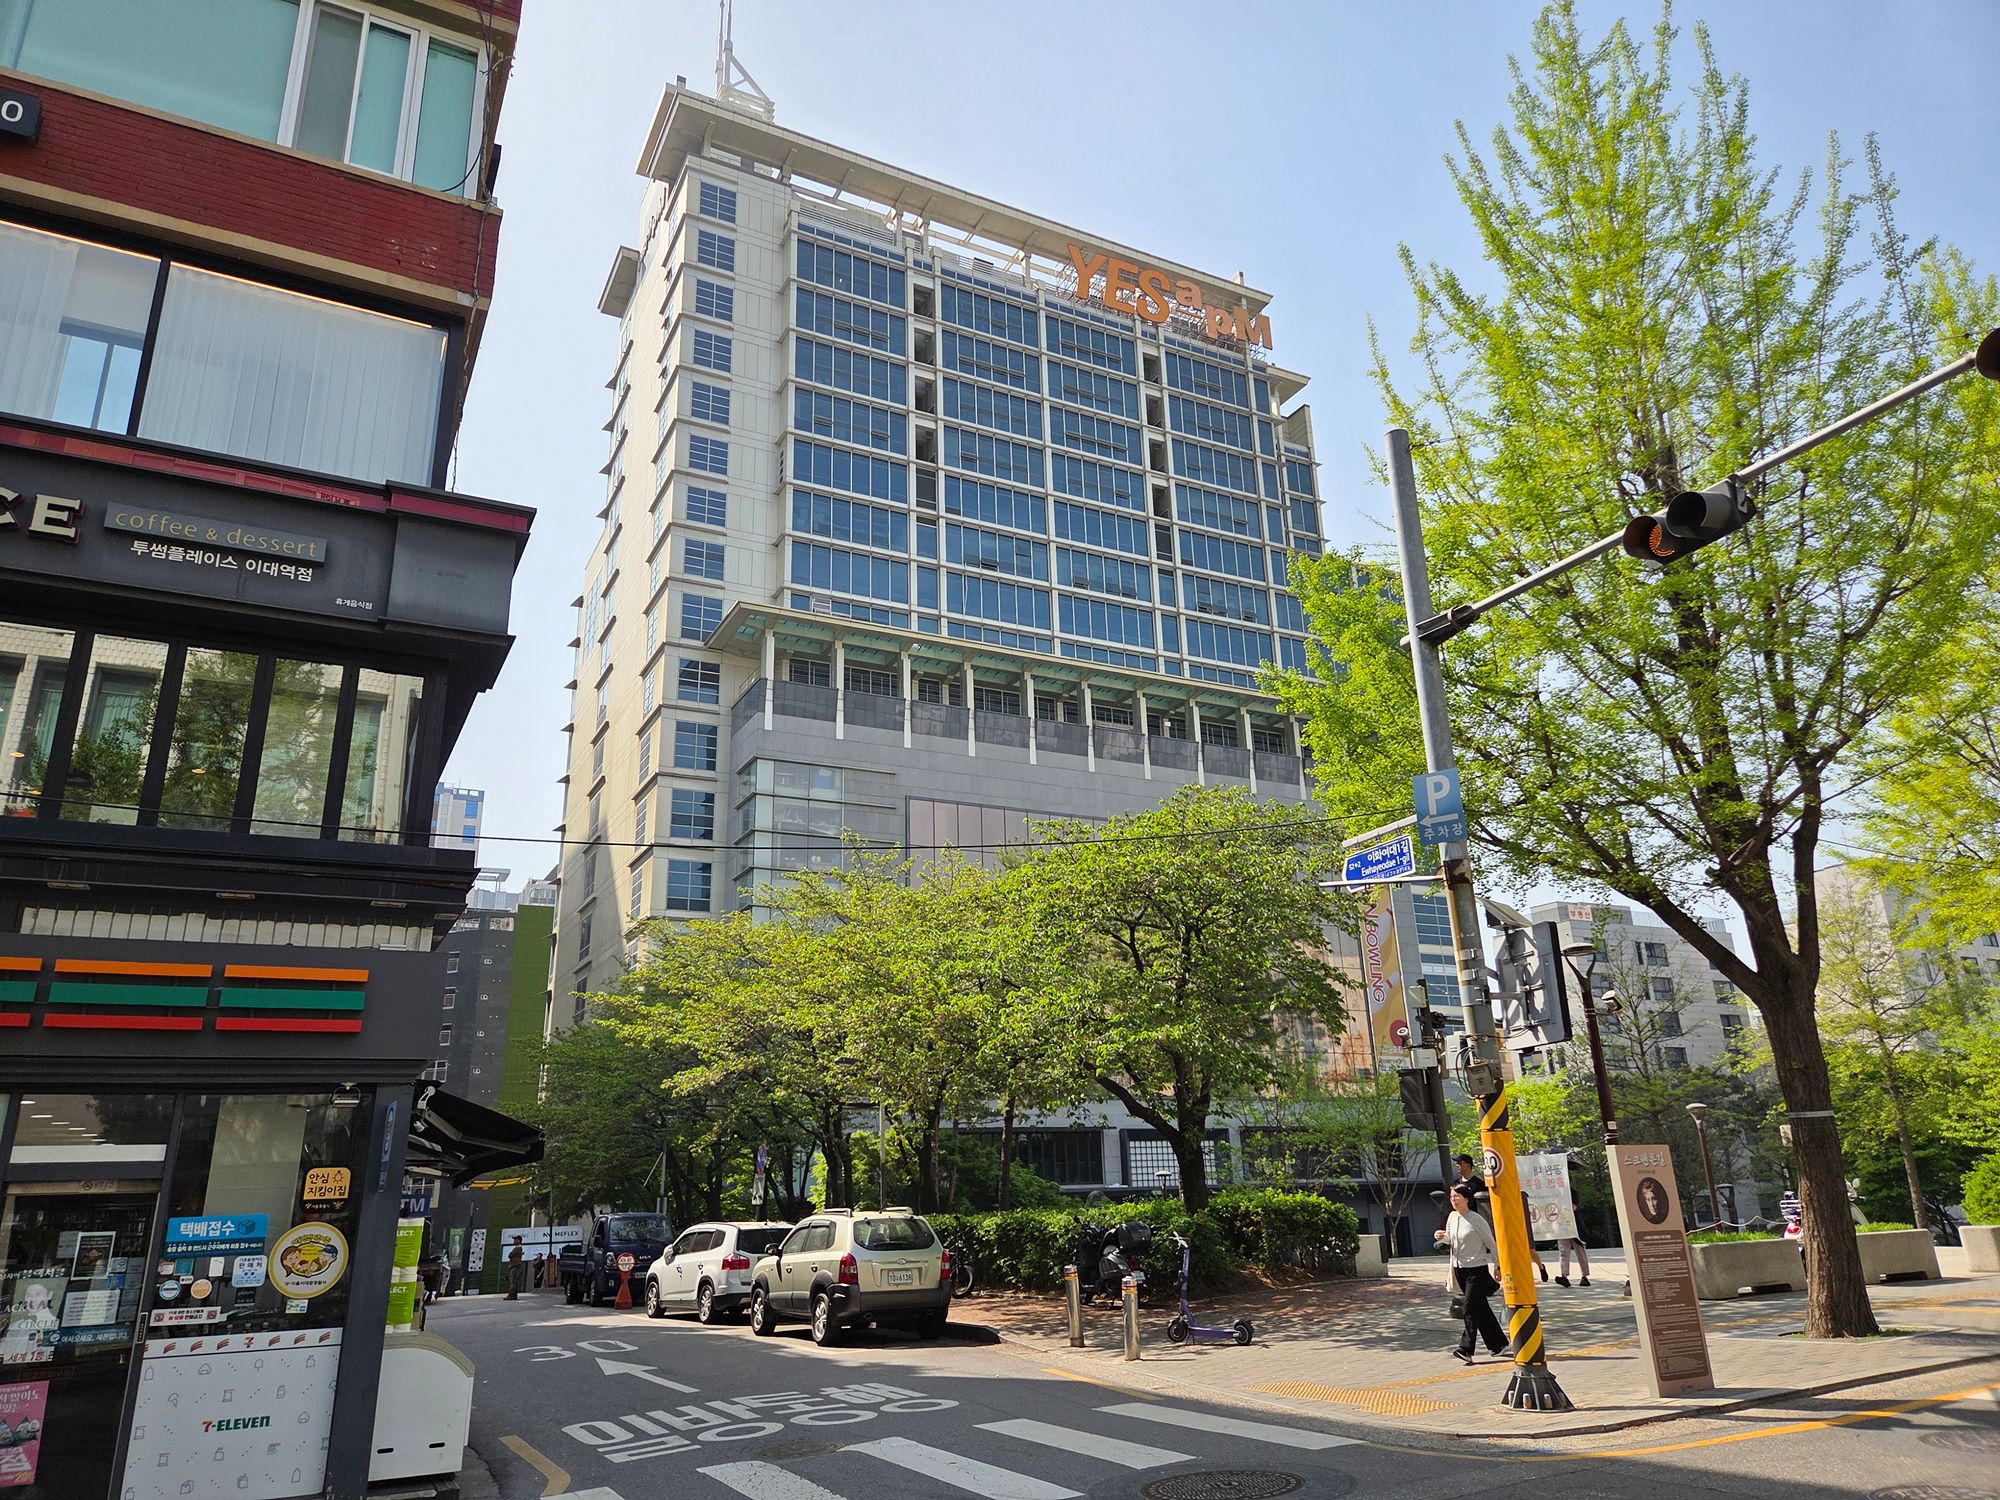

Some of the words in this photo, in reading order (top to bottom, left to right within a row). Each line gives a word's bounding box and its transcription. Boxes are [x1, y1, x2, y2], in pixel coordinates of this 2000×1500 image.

[1067, 243, 1171, 324] YES
[115, 510, 198, 537] coffee
[206, 526, 218, 541] &
[226, 528, 317, 557] dessert
[131, 540, 239, 570] 투썸플레이스
[245, 558, 314, 582] 이대역점
[335, 597, 374, 611] 휴게음식점
[1425, 775, 1451, 816] P
[1424, 823, 1463, 841] 주차장
[1367, 839, 1409, 863] 이화여대1길
[1361, 858, 1396, 877] Ewhayeodae
[1364, 922, 1385, 1004] BOWLING
[309, 1173, 330, 1185] 안심
[307, 1185, 347, 1197] 지킴이집
[180, 1220, 235, 1238] 택배접수
[513, 1339, 638, 1362] 30
[561, 1382, 960, 1464] 일방통행
